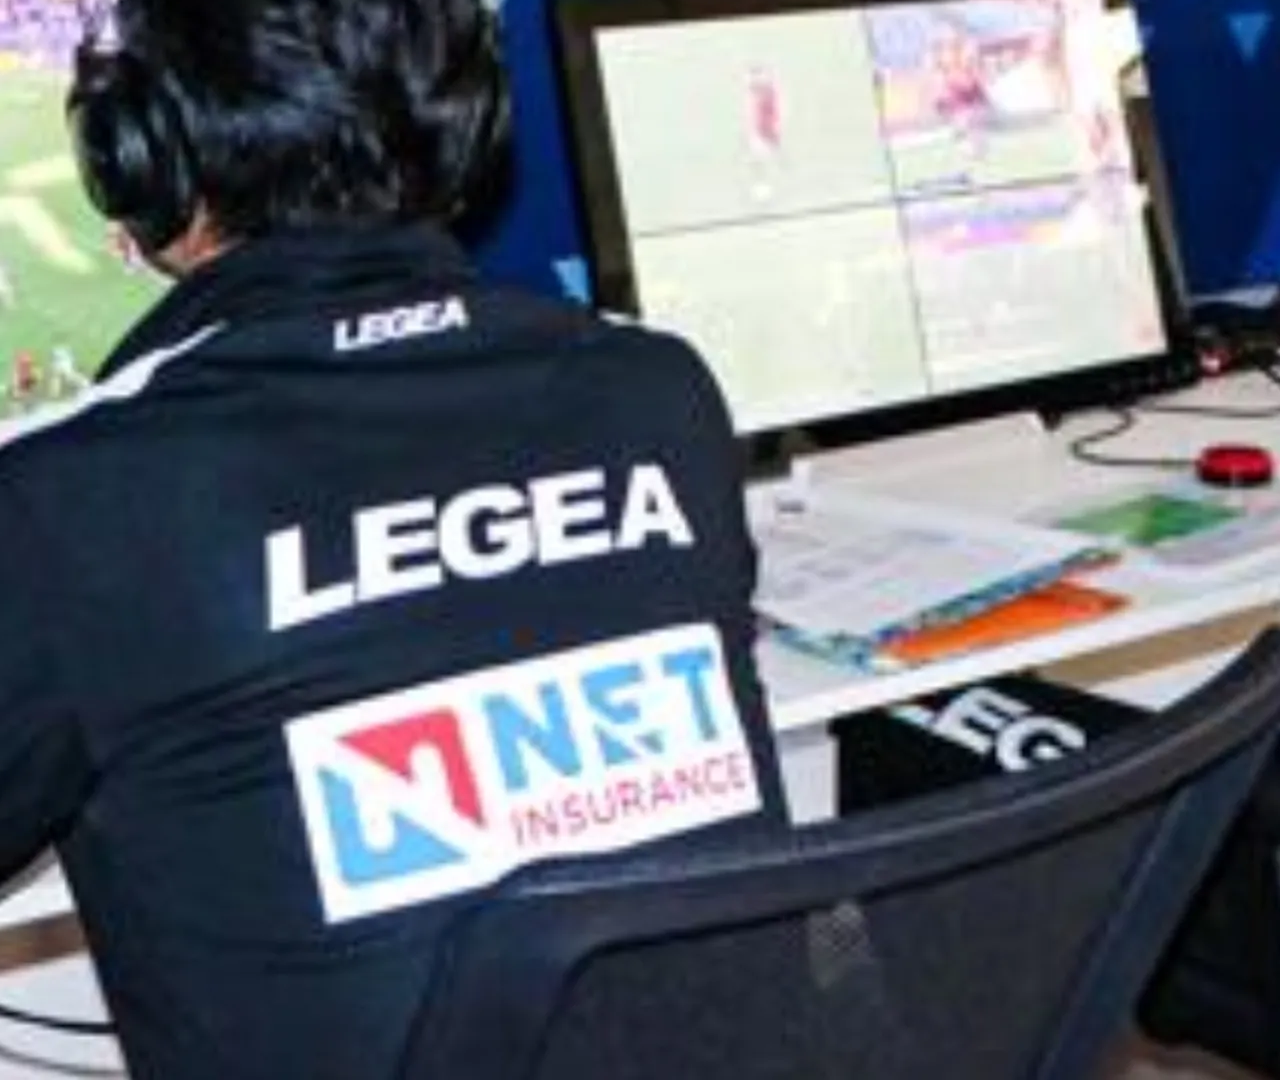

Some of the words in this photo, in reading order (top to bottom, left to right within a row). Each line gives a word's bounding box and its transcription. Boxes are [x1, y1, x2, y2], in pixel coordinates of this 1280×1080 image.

[333, 296, 468, 351] LEGEA
[264, 462, 695, 633] LEGEA
[481, 646, 717, 795] NET
[510, 751, 749, 848] INSURANCE
